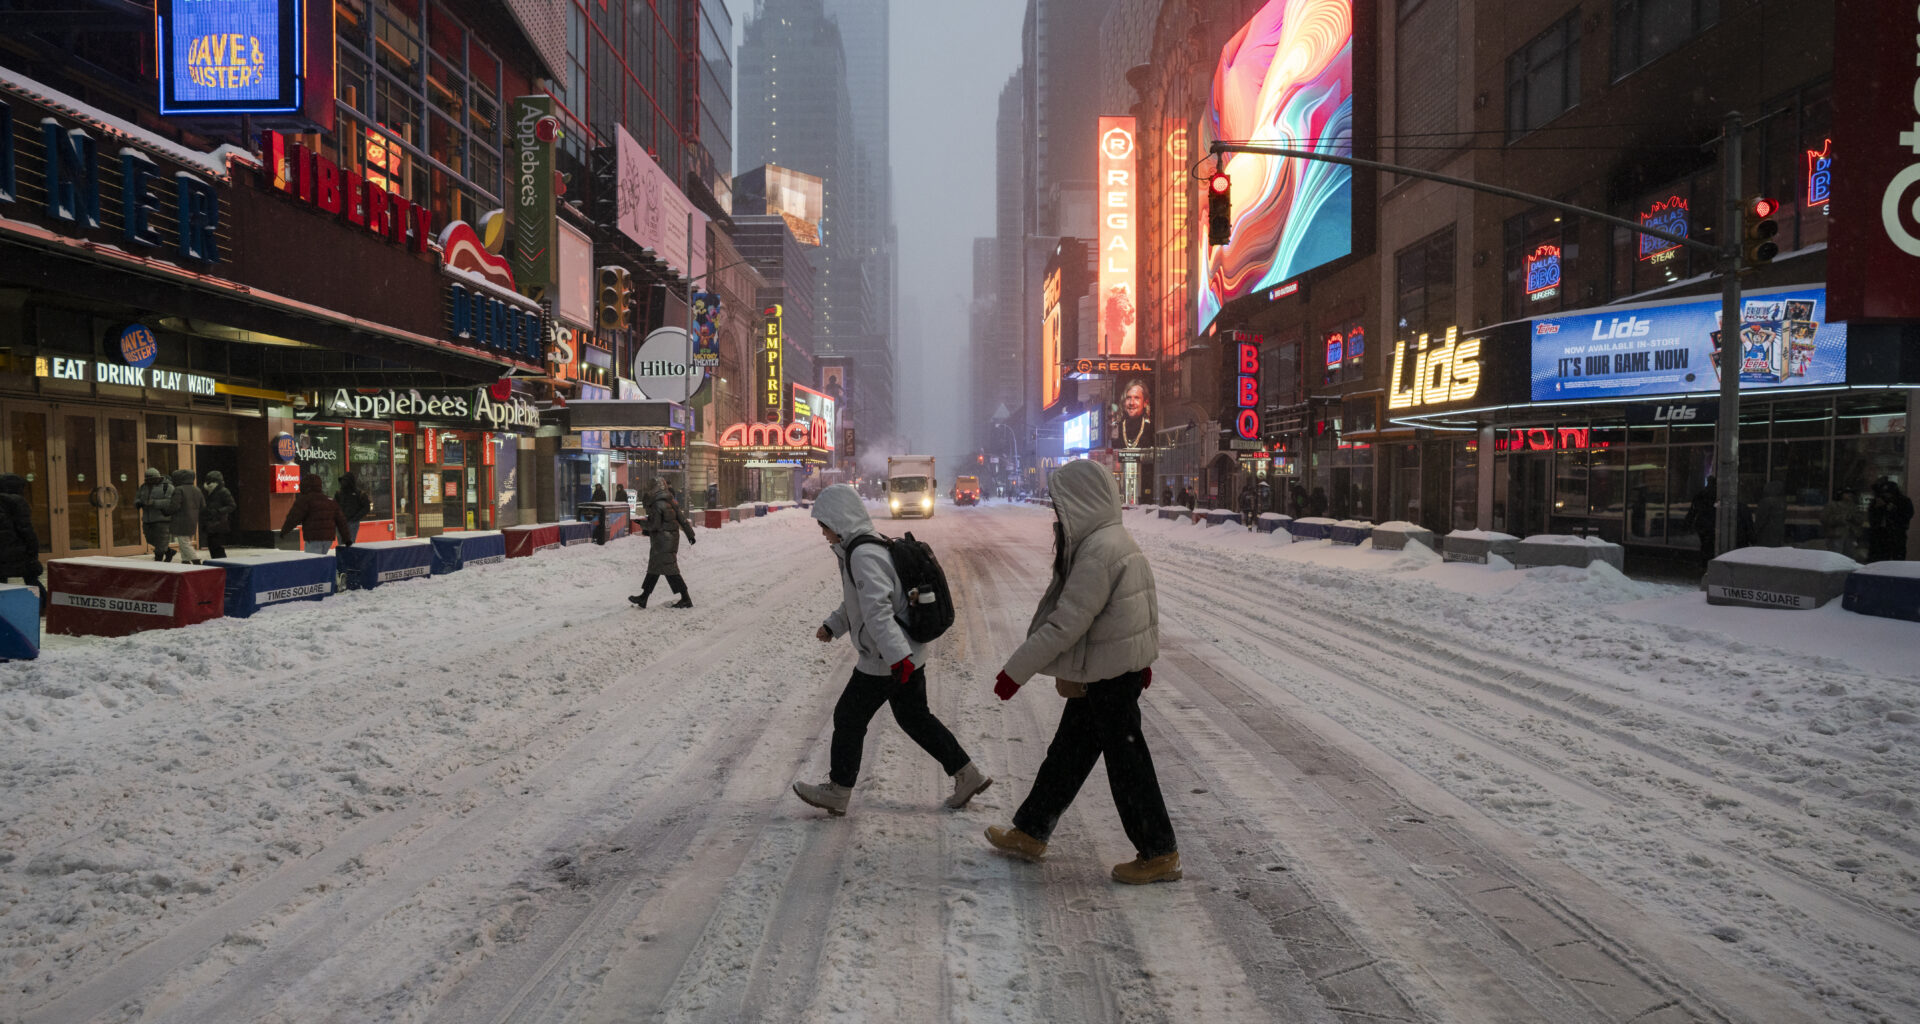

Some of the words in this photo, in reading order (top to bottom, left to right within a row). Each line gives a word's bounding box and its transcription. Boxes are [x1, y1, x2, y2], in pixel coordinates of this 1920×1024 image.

[188, 34, 246, 65] DAVE
[250, 36, 264, 65] &
[189, 65, 264, 88] BUSTER'S
[262, 128, 432, 253] LIBERTY
[1107, 169, 1129, 273] REGAL
[1531, 255, 1558, 271] DALLAS
[1651, 250, 1675, 264] STEAK
[1528, 263, 1560, 291] BBQ
[1531, 288, 1555, 301] BURGERS
[1592, 316, 1651, 341] Lids
[121, 330, 147, 352] DAVE
[144, 329, 154, 343] &
[1564, 346, 1585, 354] NOW
[1588, 341, 1633, 353] AVAILABLE
[1637, 338, 1680, 348] IN-STORE
[766, 323, 778, 405] EMPIRE
[1098, 362, 1152, 371] REGAL
[1389, 325, 1481, 409] Lids
[1558, 357, 1581, 377] IT'S
[1586, 355, 1610, 376] OUR
[1614, 351, 1650, 373] GAME
[1654, 348, 1689, 371] NOW
[53, 357, 86, 380] EAT
[97, 362, 146, 387] DRINK
[153, 369, 182, 391] PLAY
[188, 374, 216, 396] WATCH
[1236, 342, 1260, 441] BBQ
[1655, 405, 1697, 421] Lids
[267, 587, 292, 601] TIMES
[292, 583, 324, 598] SQUARE
[1721, 587, 1753, 599] TIMES
[1756, 591, 1800, 607] SQUARE
[68, 595, 106, 609] TIMES
[109, 598, 158, 614] SQUARE
